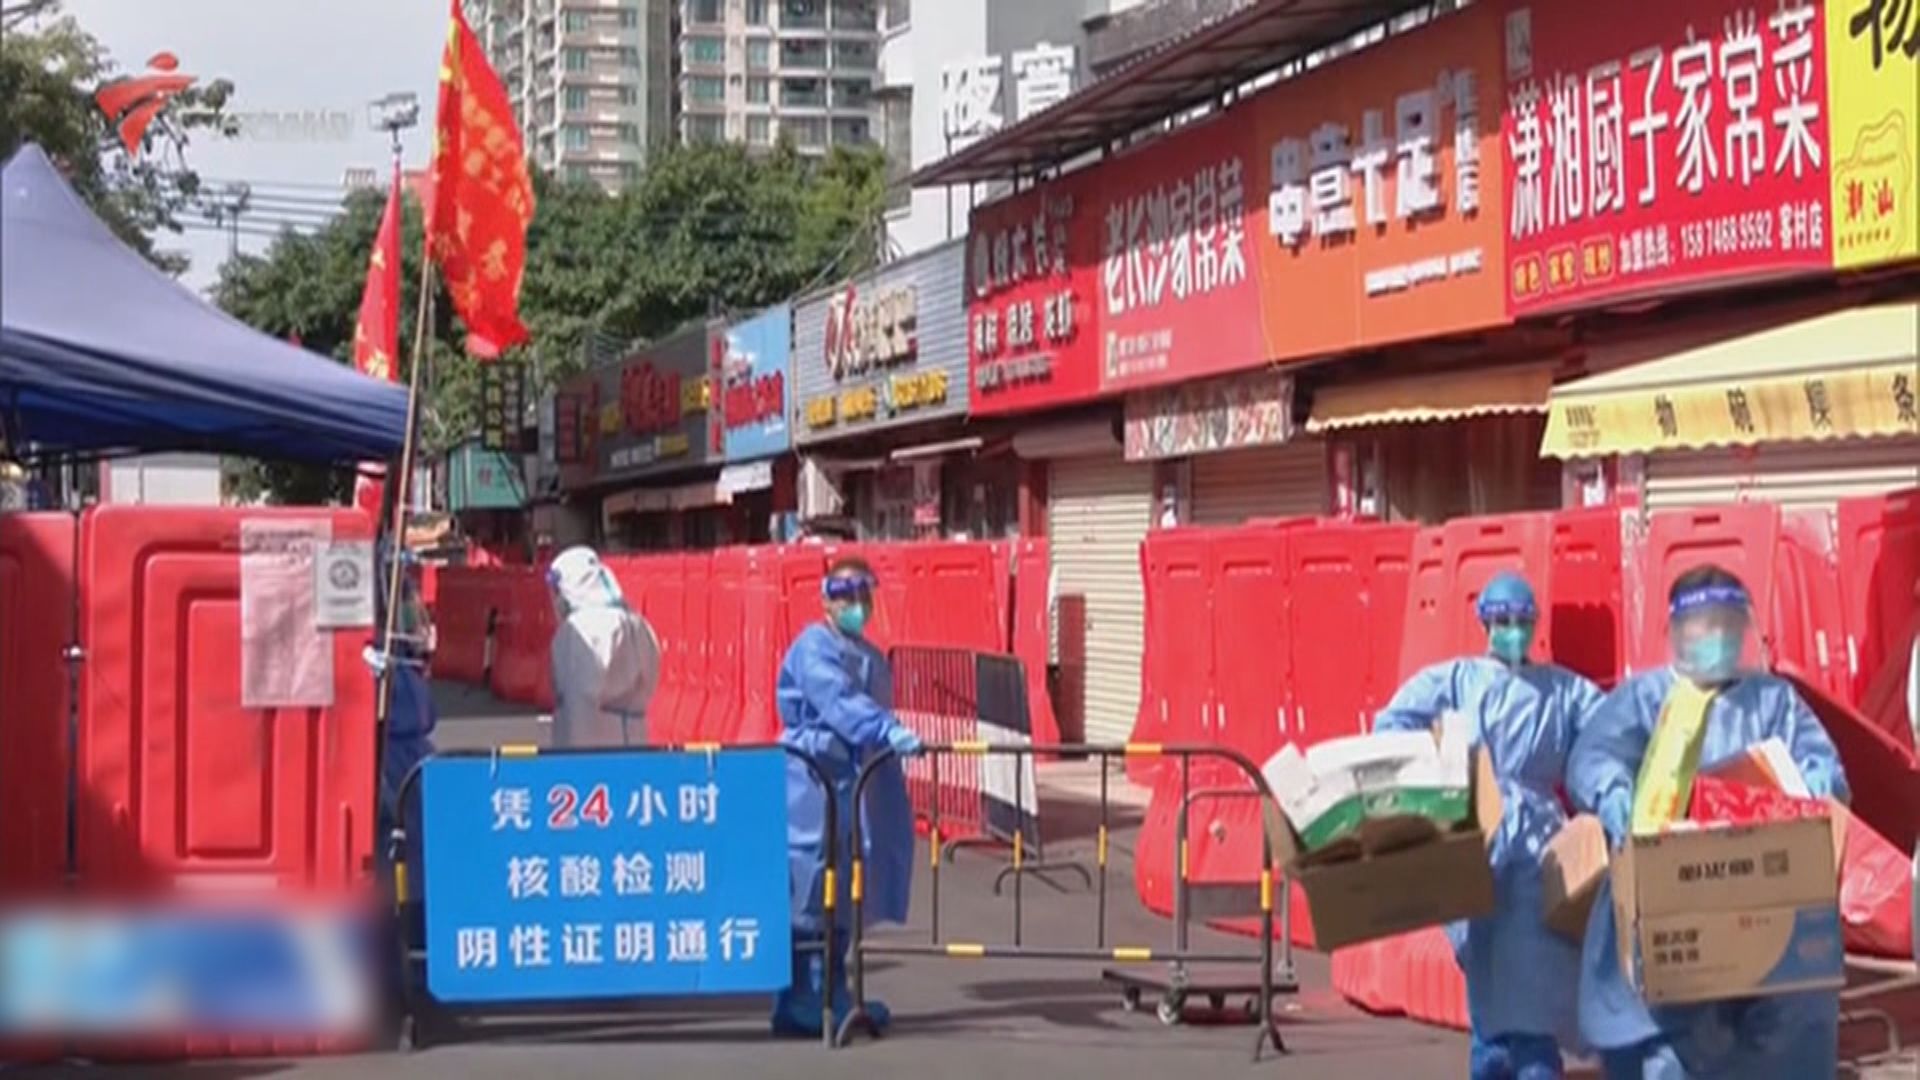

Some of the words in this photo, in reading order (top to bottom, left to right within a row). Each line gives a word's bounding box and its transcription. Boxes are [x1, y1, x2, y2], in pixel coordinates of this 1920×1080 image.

[1508, 0, 1822, 239] 潇湘厨子家常菜
[1104, 157, 1247, 314] 老长沙家常菜
[490, 782, 720, 832] 凭24小时
[508, 850, 706, 899] 核酸检测
[456, 917, 761, 969] 阴性证明通行
